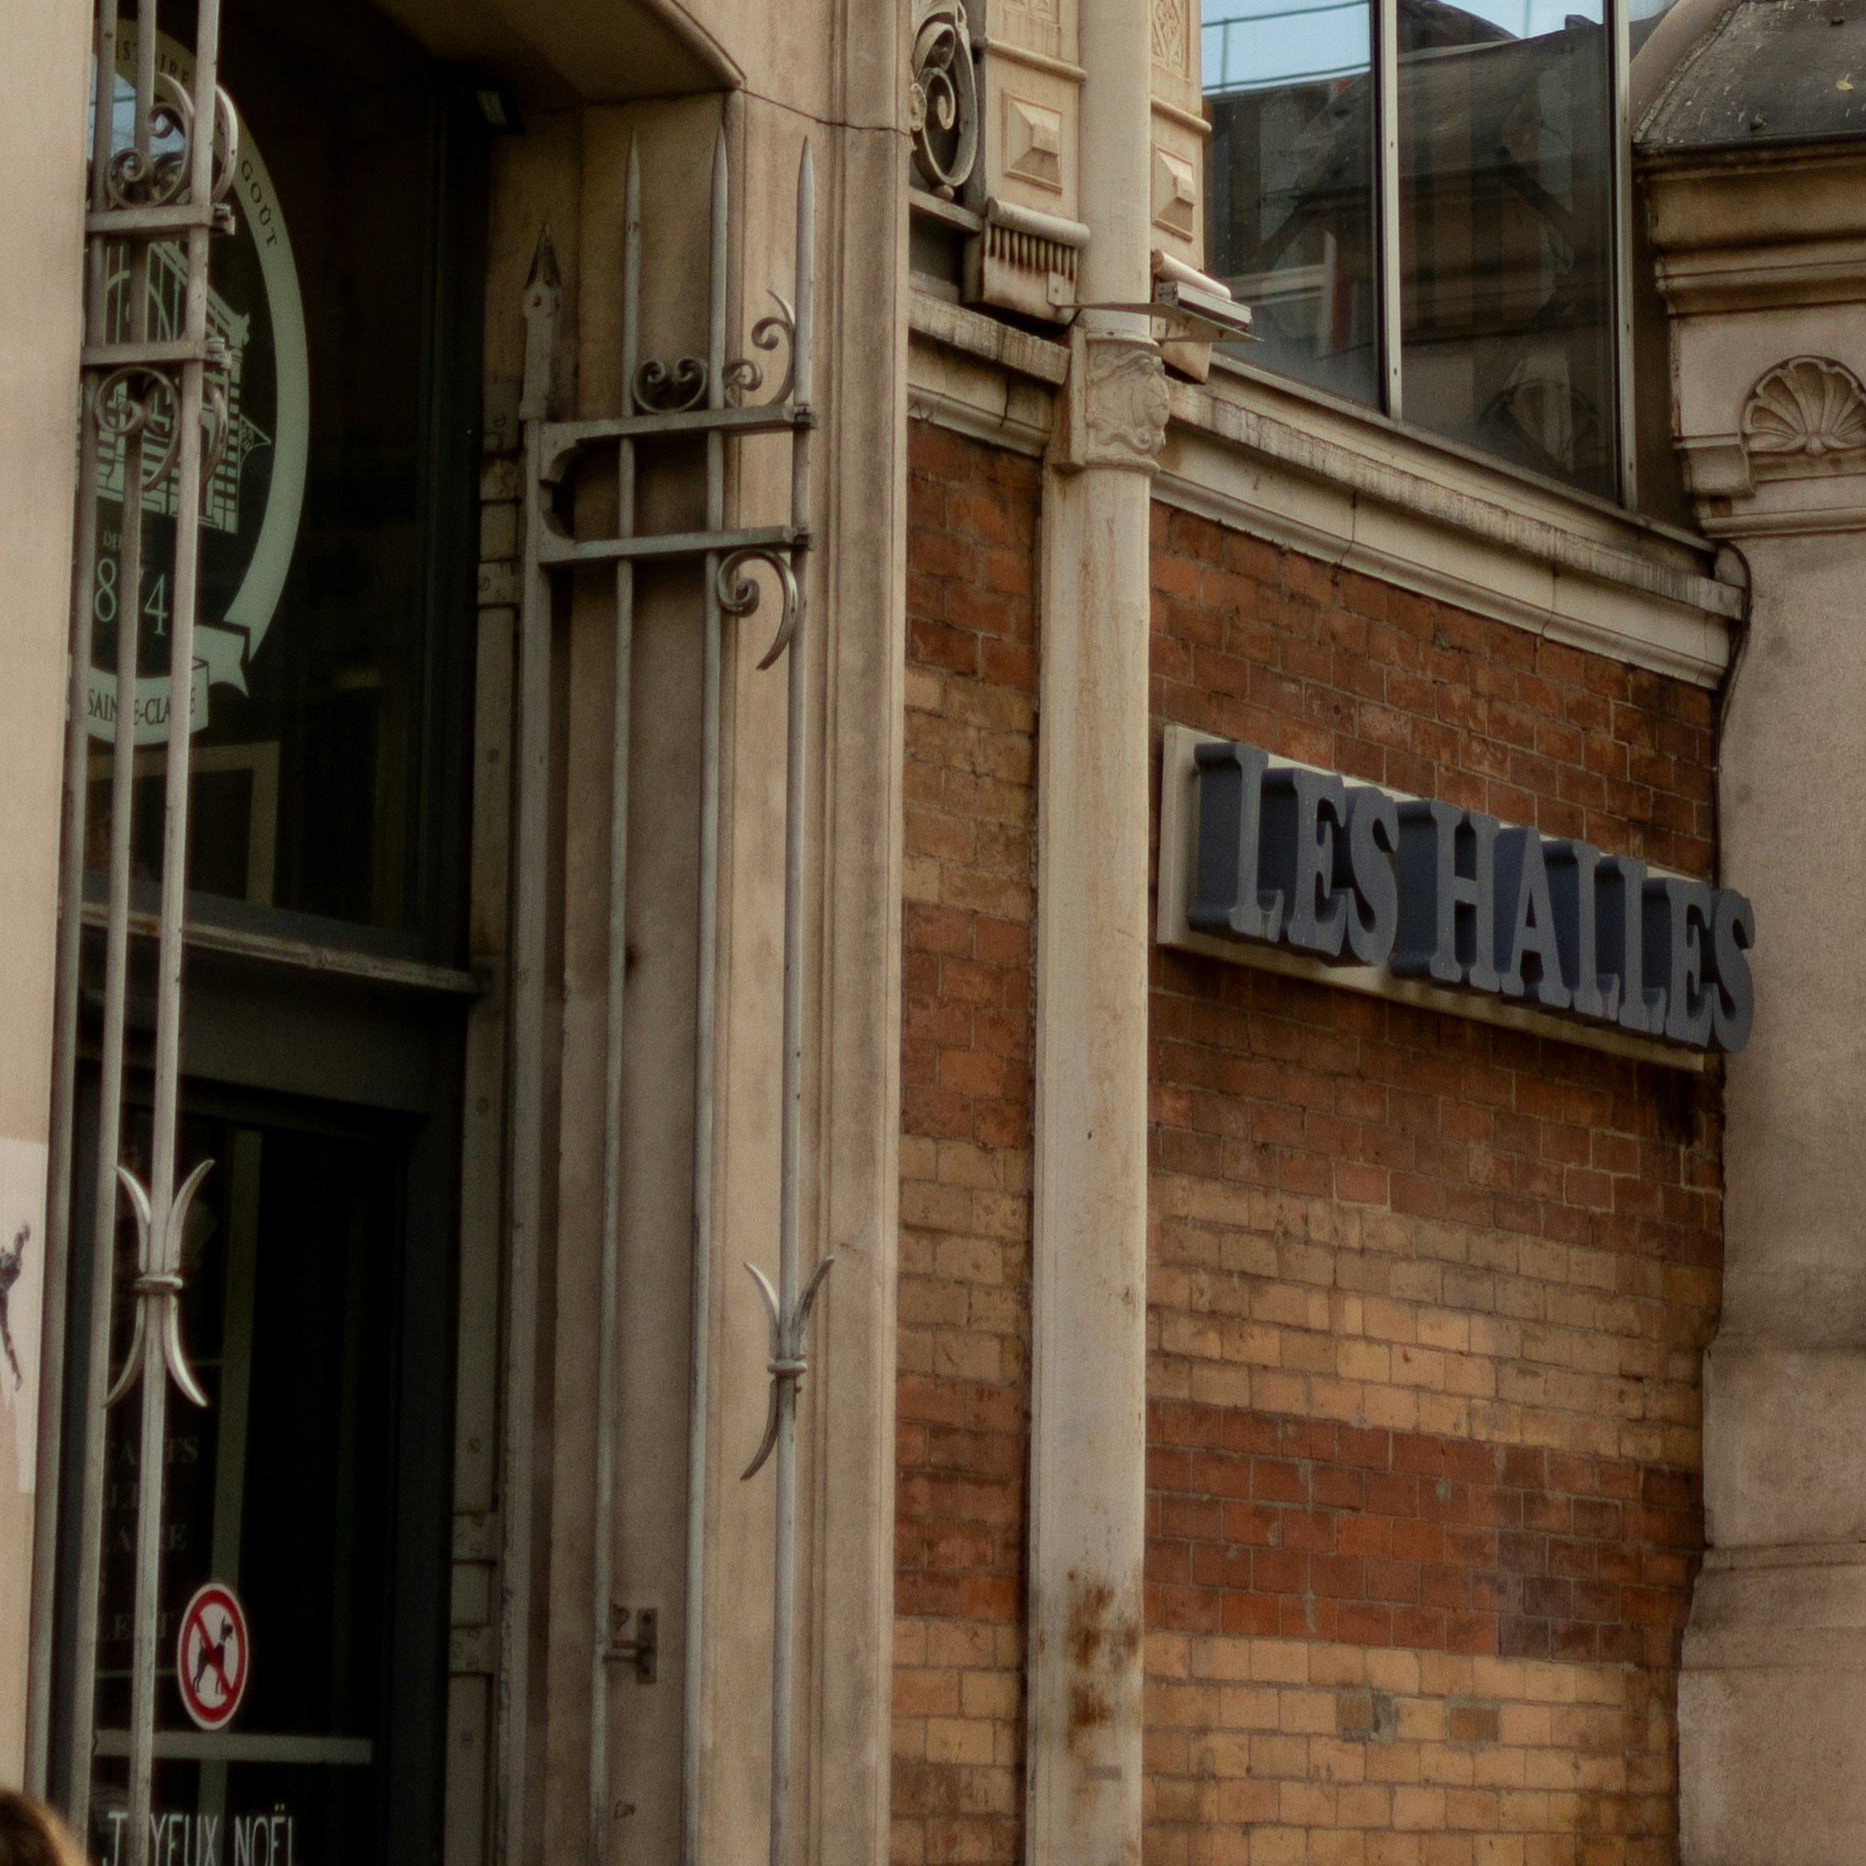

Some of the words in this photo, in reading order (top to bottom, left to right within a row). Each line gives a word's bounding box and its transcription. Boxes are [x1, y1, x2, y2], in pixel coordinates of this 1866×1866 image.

[1190, 741, 1399, 965] LES
[1393, 797, 1755, 1054] HALLES
[102, 1810, 219, 1866] JYEUX
